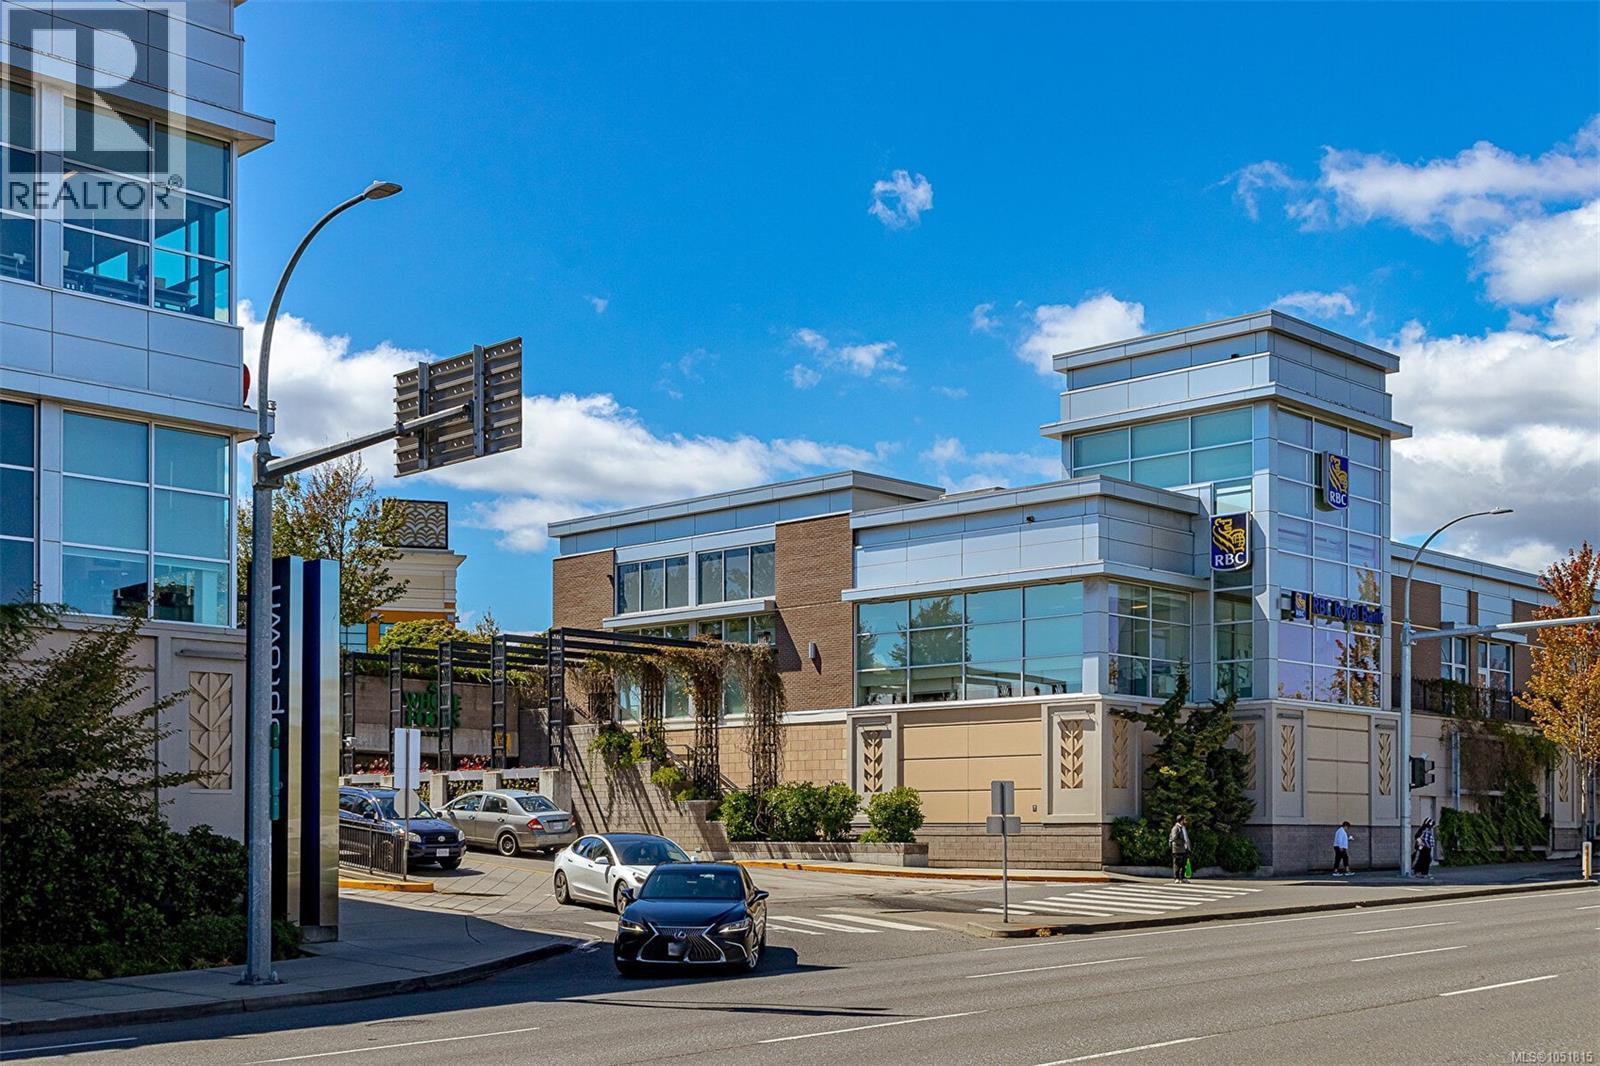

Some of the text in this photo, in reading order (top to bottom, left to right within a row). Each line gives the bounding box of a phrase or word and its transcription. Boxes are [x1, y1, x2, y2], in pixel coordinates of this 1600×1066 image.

[1329, 490, 1347, 506] RBC
[1215, 552, 1245, 567] RBC
[1335, 601, 1359, 622] Royal
[1361, 604, 1384, 625] Bank
